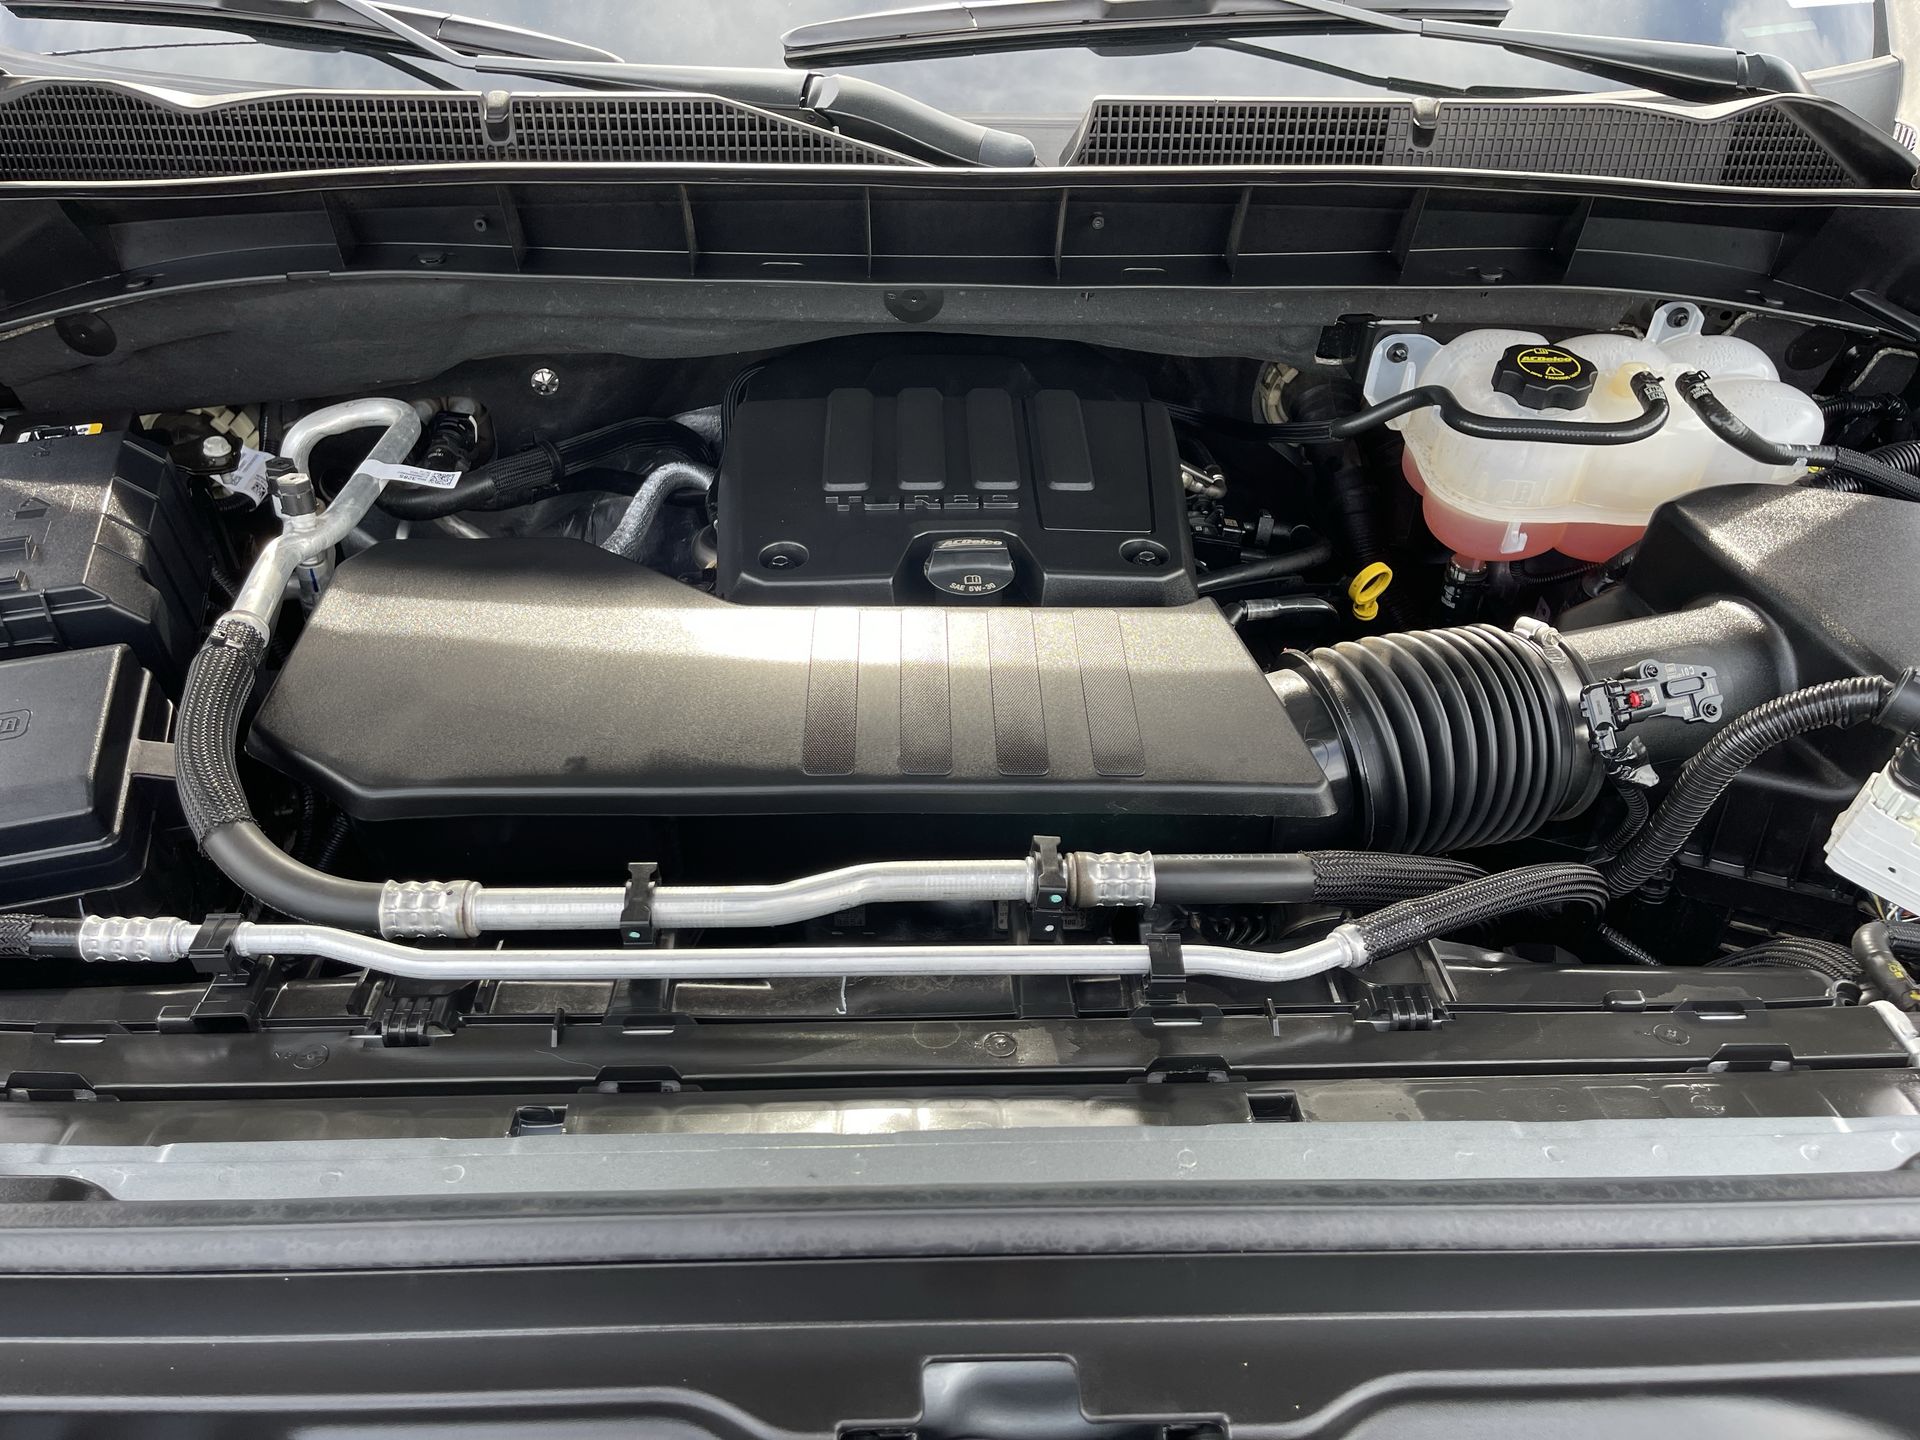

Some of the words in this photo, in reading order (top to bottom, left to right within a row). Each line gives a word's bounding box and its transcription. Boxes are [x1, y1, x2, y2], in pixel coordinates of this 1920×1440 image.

[825, 494, 1019, 512] TURBO
[939, 538, 1003, 548] ACDelco
[949, 582, 966, 591] SAE
[968, 582, 997, 592] 5W-30
